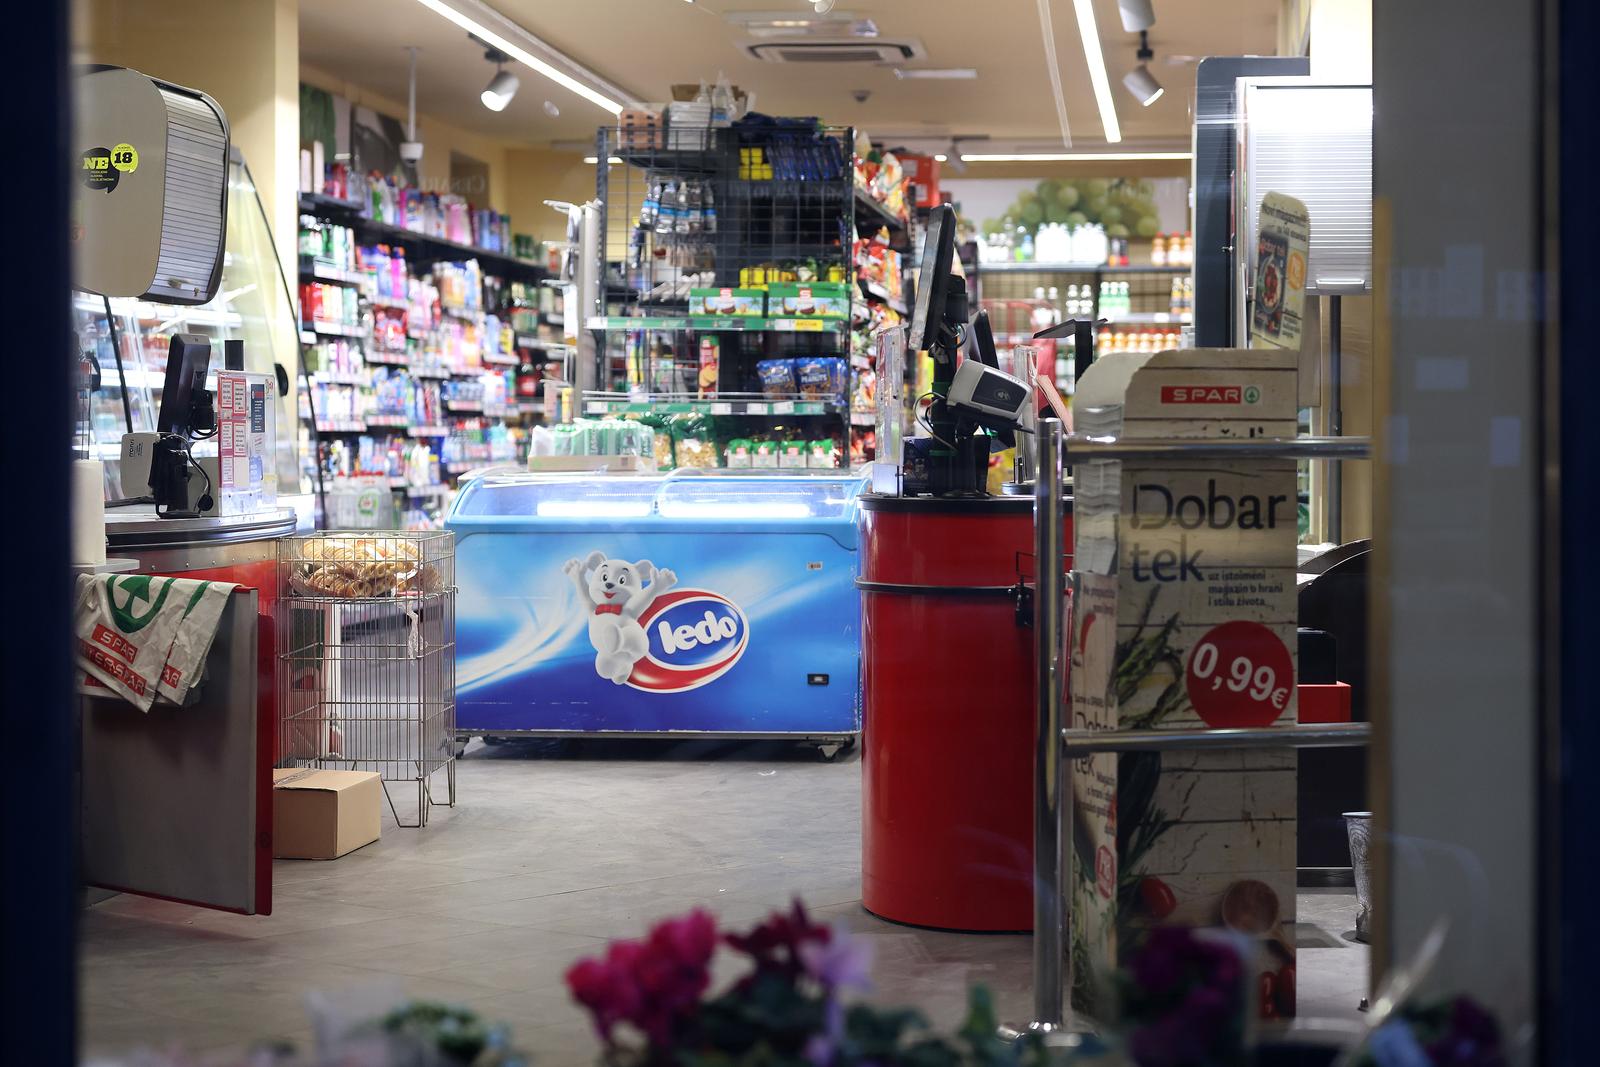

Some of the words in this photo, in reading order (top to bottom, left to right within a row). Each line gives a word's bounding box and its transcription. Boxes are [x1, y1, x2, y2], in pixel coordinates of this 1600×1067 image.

[83, 157, 109, 169] NE
[115, 152, 132, 163] 18
[1173, 389, 1239, 401] SPAR
[1130, 479, 1287, 530] Dobar
[1130, 534, 1205, 582] tek
[1208, 583, 1248, 597] magazin
[1258, 582, 1283, 593] hrani
[101, 631, 136, 664] SPAR
[1193, 643, 1288, 709] 0,99€
